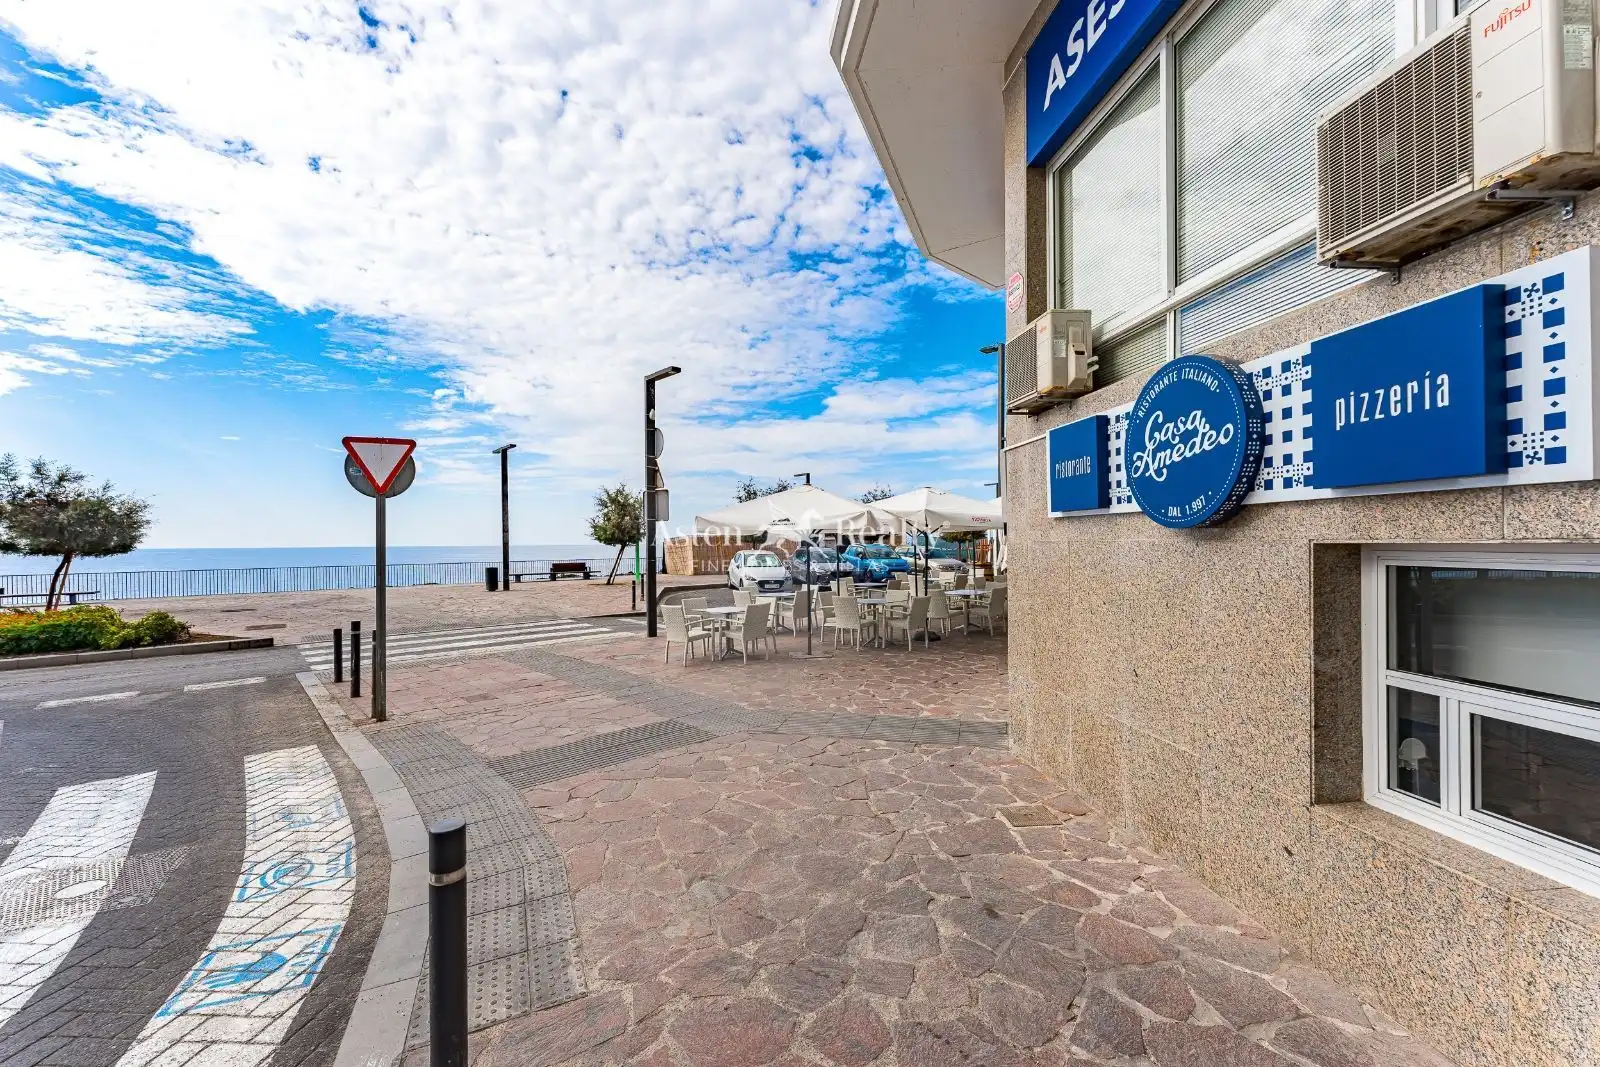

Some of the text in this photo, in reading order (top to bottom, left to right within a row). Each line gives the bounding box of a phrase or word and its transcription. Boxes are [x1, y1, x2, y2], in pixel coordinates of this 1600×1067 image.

[1138, 368, 1219, 418] RISTORANTE ITALIANO
[1335, 370, 1449, 431] pizzería
[1132, 418, 1234, 482] Amedeo
[1144, 410, 1204, 447] Casa
[1055, 455, 1091, 480] ristorante
[1167, 495, 1207, 518] DAL 1.997
